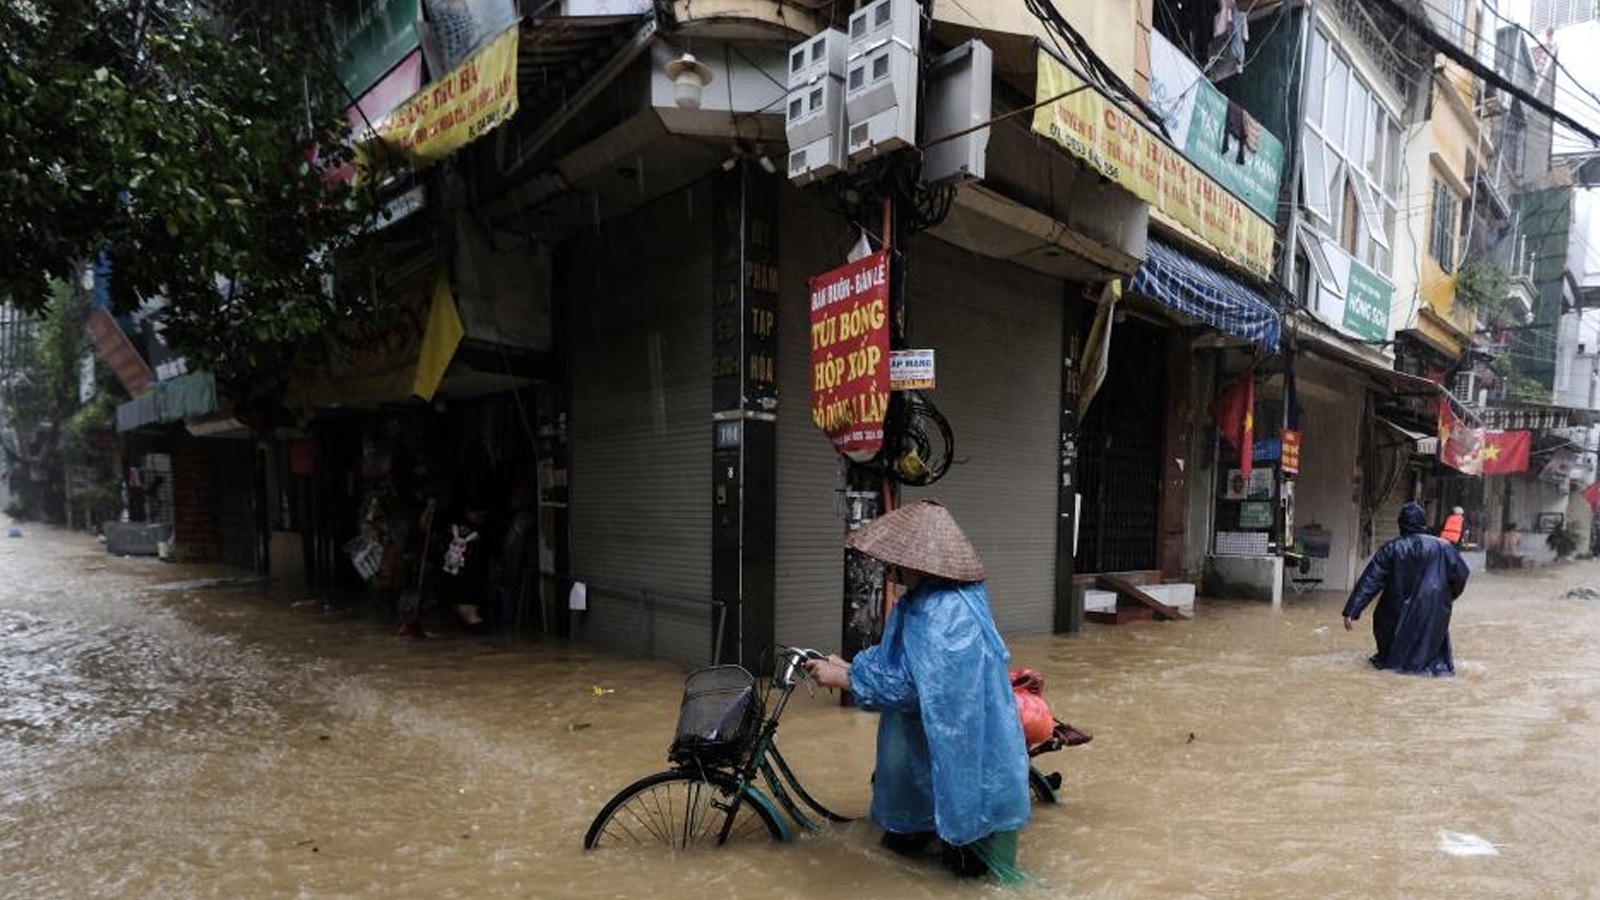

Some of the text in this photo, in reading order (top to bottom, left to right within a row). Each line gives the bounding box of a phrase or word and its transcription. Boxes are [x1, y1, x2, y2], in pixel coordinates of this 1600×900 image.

[811, 299, 886, 351] TÚI BÓNG
[814, 336, 881, 394] HỘP XỐP
